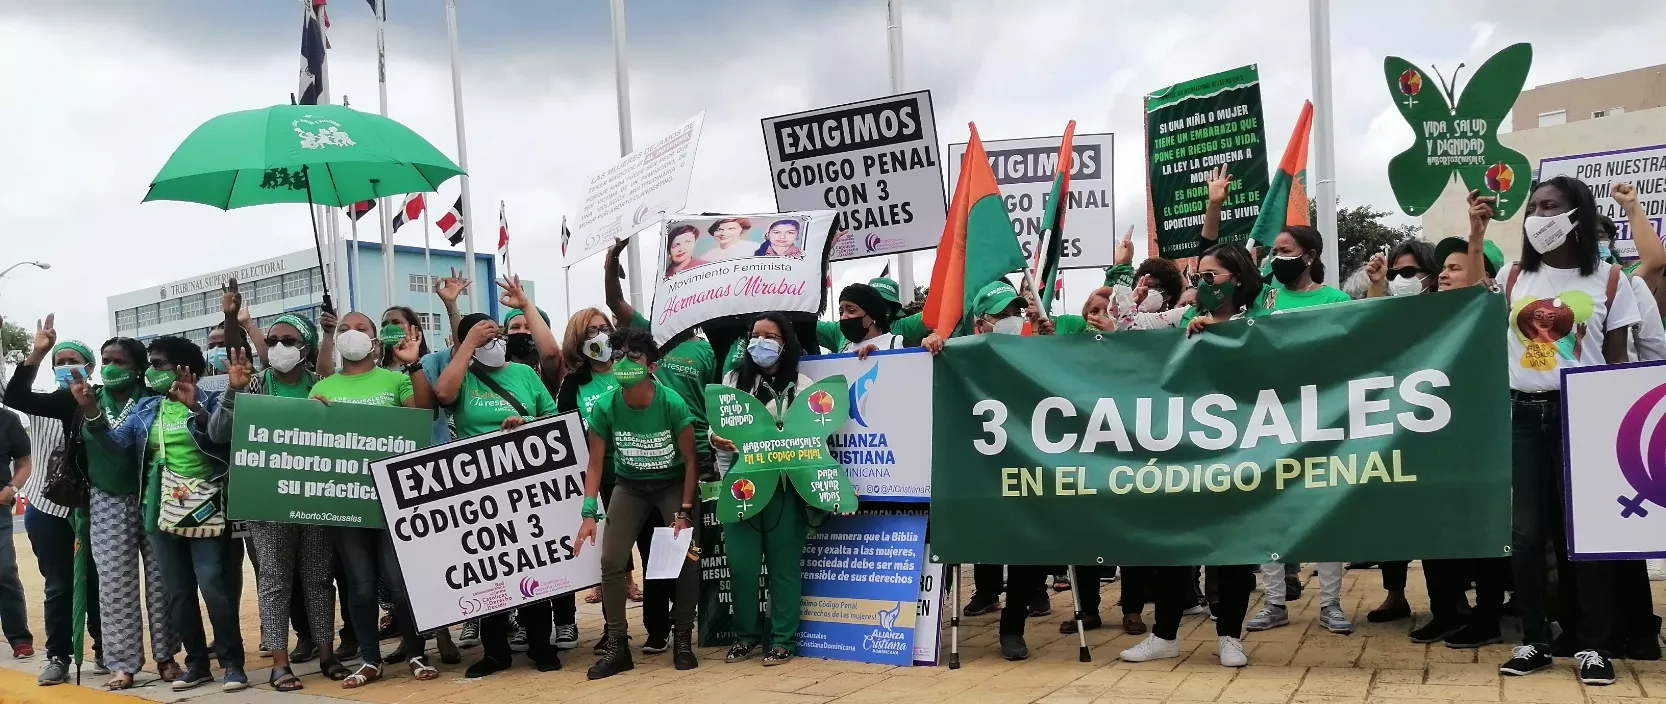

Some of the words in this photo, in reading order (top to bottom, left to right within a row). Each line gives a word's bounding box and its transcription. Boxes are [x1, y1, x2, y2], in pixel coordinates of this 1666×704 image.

[1160, 123, 1167, 134] SI
[1169, 119, 1184, 132] UNA
[1186, 112, 1206, 127] NIÑA
[1208, 112, 1214, 122] O
[1217, 104, 1248, 120] MUJER
[781, 106, 916, 154] EXIGIMOS
[1155, 136, 1175, 149] TIENE
[1178, 133, 1188, 144] UN
[1190, 122, 1238, 140] EMBARAZO
[1240, 118, 1258, 131] QUE
[1423, 120, 1450, 138] VIDA,
[1454, 119, 1487, 136] SALUD
[592, 172, 605, 184] LAS
[607, 152, 642, 175] MUJERES
[644, 130, 682, 154] DEJAMOS
[684, 121, 695, 132] DE
[1154, 151, 1174, 164] PONE
[1176, 147, 1186, 158] EN
[1188, 140, 1218, 156] RIESGO
[1221, 137, 1232, 149] SU
[1235, 133, 1260, 146] VIDA,
[1426, 140, 1433, 155] Y
[1437, 138, 1485, 155] DIGNIDAD
[776, 158, 855, 189] CÓDIGO
[863, 146, 935, 177] PENAL
[1163, 164, 1172, 175] LA
[1174, 160, 1188, 172] LEY
[1190, 158, 1200, 170] LA
[1202, 150, 1244, 167] CONDENA
[1246, 148, 1252, 159] A
[1577, 163, 1601, 180] POR
[824, 182, 868, 208] CON
[877, 180, 889, 201] 3
[1175, 190, 1184, 201] ES
[1187, 186, 1208, 198] HORA
[1164, 206, 1172, 217] EL
[1174, 200, 1203, 216] CÓDIGO
[1235, 194, 1245, 204] LE
[1249, 190, 1260, 201] DE
[838, 202, 913, 231] USALES
[1221, 209, 1232, 220] DE
[1234, 205, 1260, 219] VIVIR
[171, 280, 204, 295] TRIBUNAL
[205, 271, 239, 288] SUPERIOR
[241, 260, 286, 279] ELECTORAL
[668, 268, 730, 293] Movimiento
[733, 263, 792, 273] Feminista
[659, 284, 732, 325] Hermanas
[734, 275, 806, 297] Mirabal
[719, 394, 738, 404] VIDA,
[720, 404, 742, 416] SALUD
[972, 399, 1008, 455] 3
[1031, 369, 1452, 454] CAUSALES
[720, 414, 754, 427] DIGNIDAD
[249, 425, 269, 442] La
[273, 428, 417, 453] criminalización
[743, 437, 821, 454] #ABORTO3CAUSALES
[827, 433, 888, 447] ALIANZA
[235, 449, 265, 468] del
[270, 452, 332, 472] aborto
[336, 459, 358, 474] no
[398, 429, 568, 500] EXIGIMOS
[745, 454, 754, 464] EN
[757, 454, 765, 463] EL
[768, 450, 795, 463] CODIGO
[798, 449, 822, 460] PENAL
[830, 450, 895, 464] RISTIANA
[817, 469, 838, 480] PARA
[1001, 468, 1042, 497] EN
[1055, 466, 1098, 496] EL
[1109, 457, 1262, 494] CÓDIGO
[1275, 449, 1417, 490] PENAL
[278, 480, 300, 494] su
[811, 481, 839, 492] SALVAR
[819, 491, 840, 502] VIDAS
[290, 510, 362, 523] #Aborto3Causales
[395, 495, 499, 542] CÓDIGO
[461, 520, 519, 555] CON
[528, 514, 544, 539] 3
[830, 533, 861, 541] manera
[864, 534, 880, 543] que
[881, 531, 889, 541] la
[891, 531, 918, 542] Biblia
[818, 546, 823, 556] y
[824, 545, 851, 555] exalta
[861, 545, 874, 556] las
[876, 546, 915, 558] mujeres,
[446, 536, 575, 589] CAUSALES
[807, 557, 849, 568] sociedad
[851, 558, 874, 570] debe
[876, 562, 891, 570] ser
[894, 559, 914, 570] más
[838, 571, 849, 581] de
[851, 574, 866, 582] sus
[869, 572, 912, 583] derechos
[819, 600, 839, 609] Código
[841, 601, 857, 609] Penal
[804, 610, 830, 618] derechos
[832, 610, 839, 618] de
[863, 634, 907, 650] Cristiana
[872, 629, 904, 640] ALIANZA
